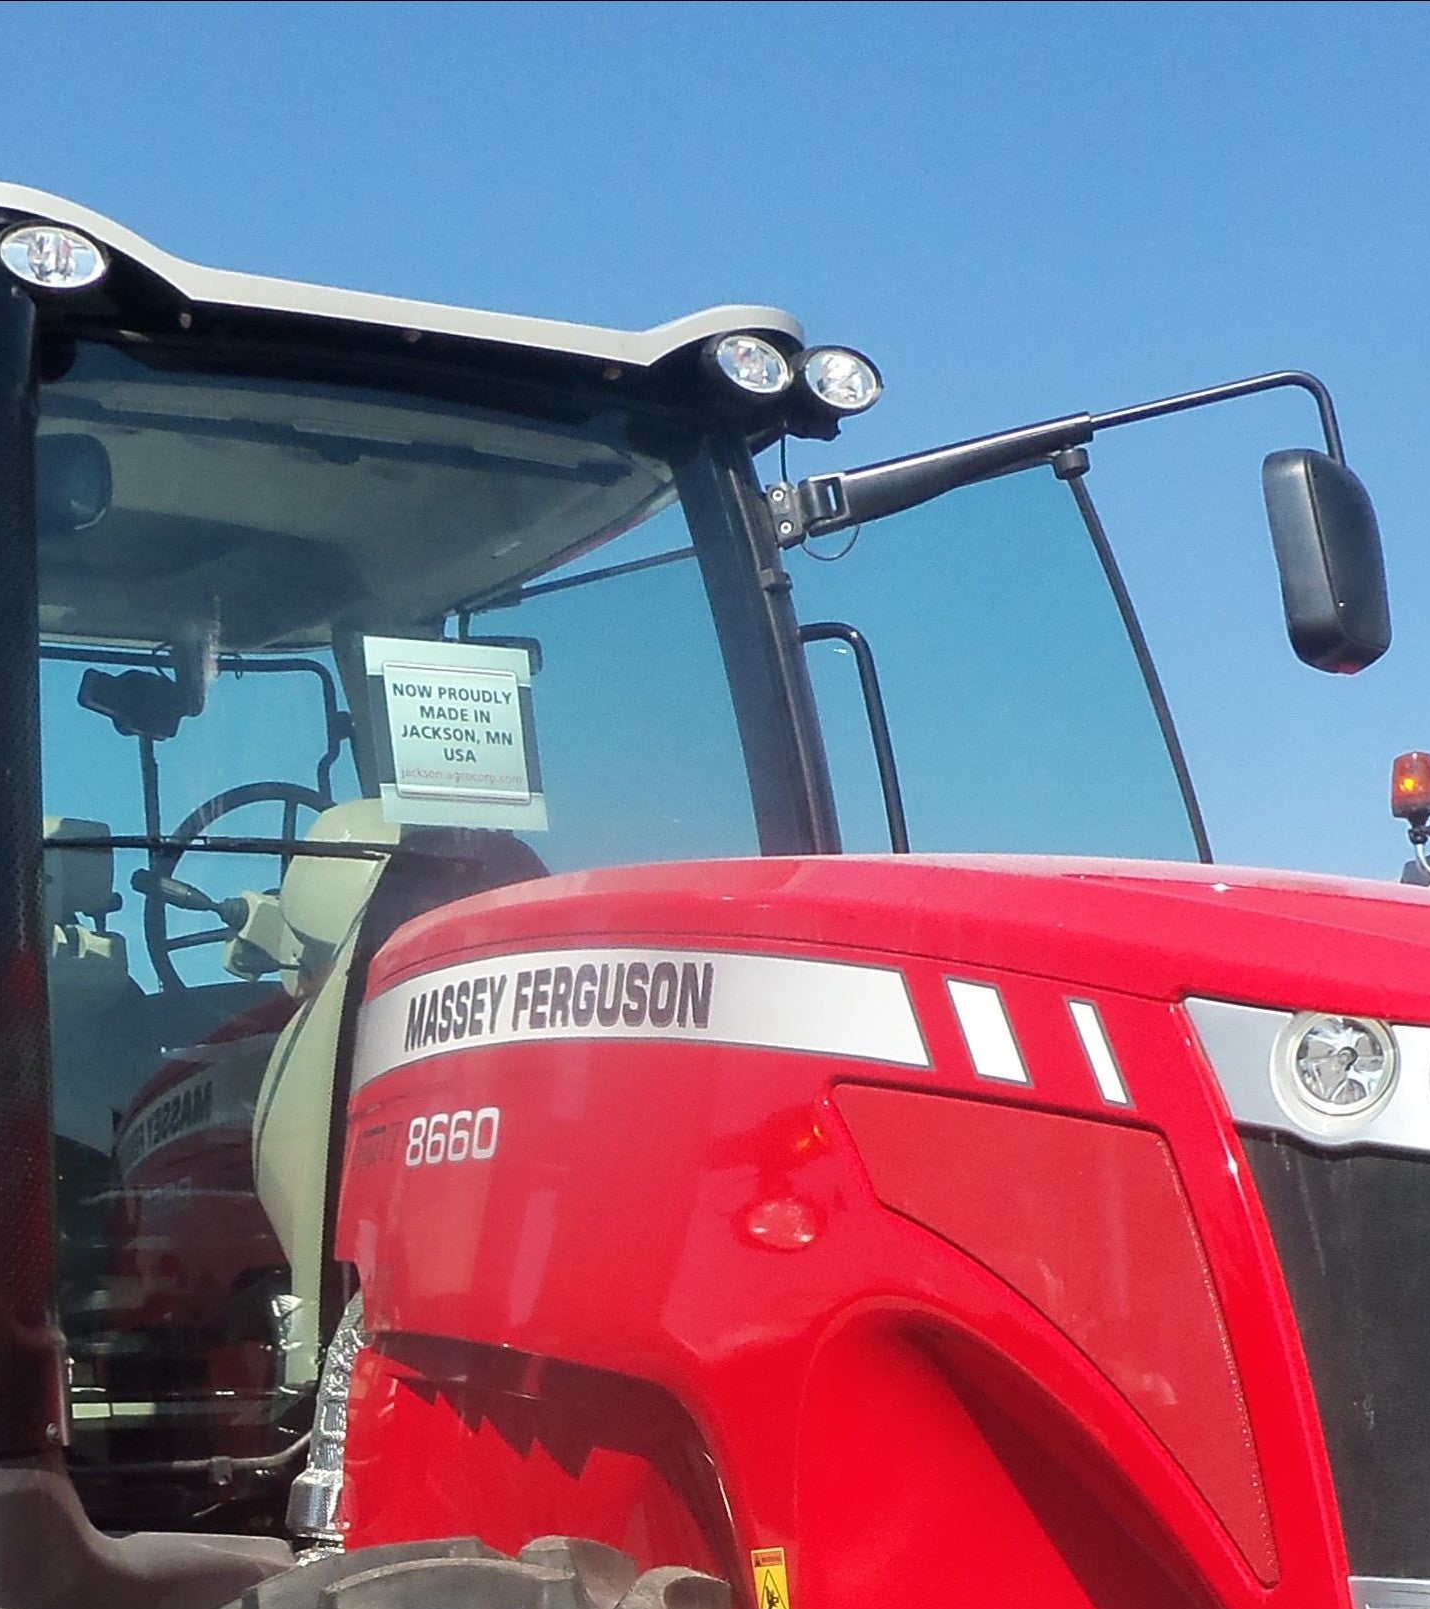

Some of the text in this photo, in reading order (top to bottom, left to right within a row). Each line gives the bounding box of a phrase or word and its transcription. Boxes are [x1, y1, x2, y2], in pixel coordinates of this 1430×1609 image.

[392, 682, 513, 706] NOW PROUDLY
[419, 705, 491, 724] MADE IN
[401, 724, 513, 746] JACKSON, MN
[443, 748, 477, 763] USA
[404, 961, 715, 1052] MASSEY FERGUSON
[405, 1106, 500, 1167] 8660
